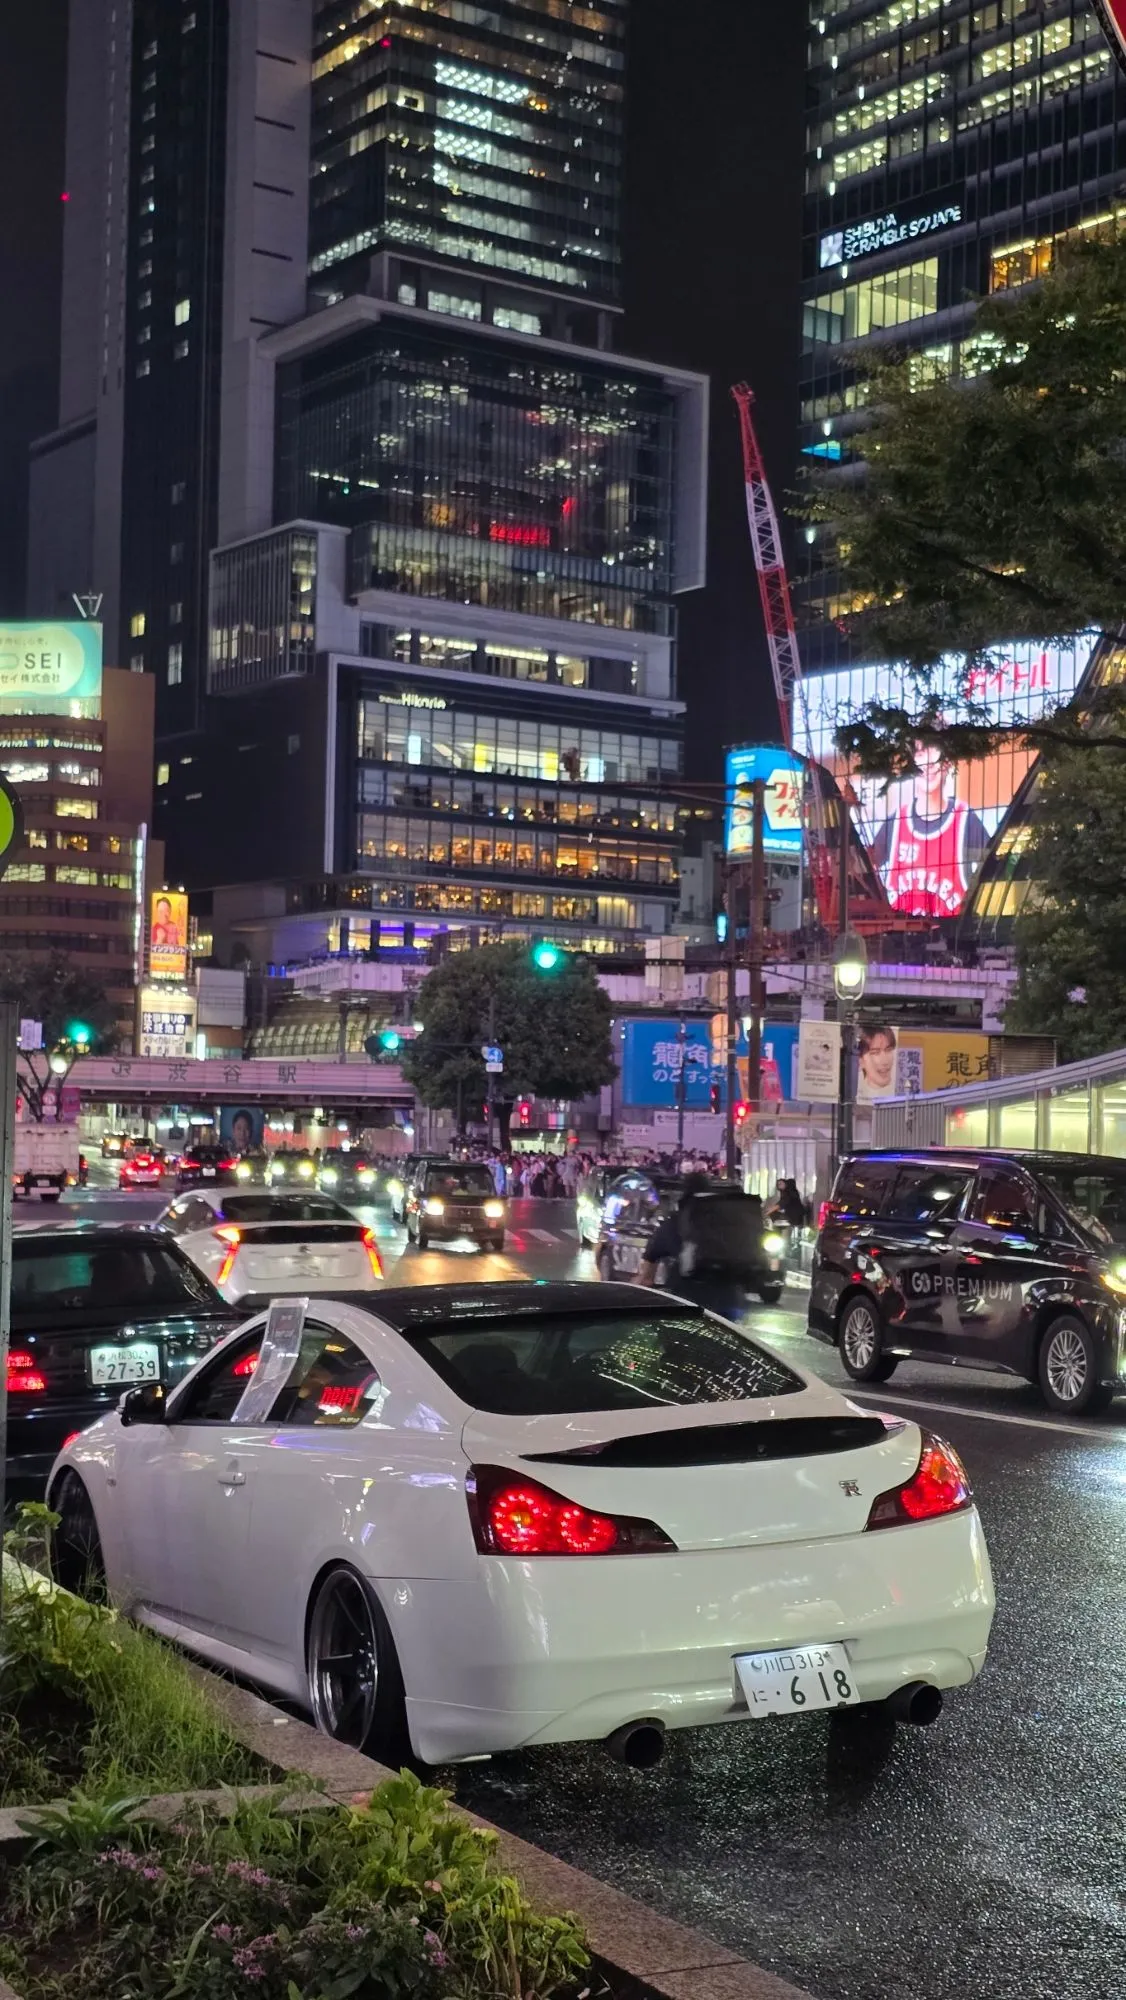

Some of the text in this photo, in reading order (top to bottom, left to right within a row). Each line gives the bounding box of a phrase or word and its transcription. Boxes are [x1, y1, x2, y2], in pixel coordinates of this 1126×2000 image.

[844, 213, 897, 244] SHIBUYA
[844, 205, 962, 259] SCRAMBLE SQUARE
[24, 652, 62, 669] SEI
[402, 693, 446, 710] Hikarie
[934, 1276, 1013, 1301] PREMIUM
[107, 1360, 156, 1380] 27-39
